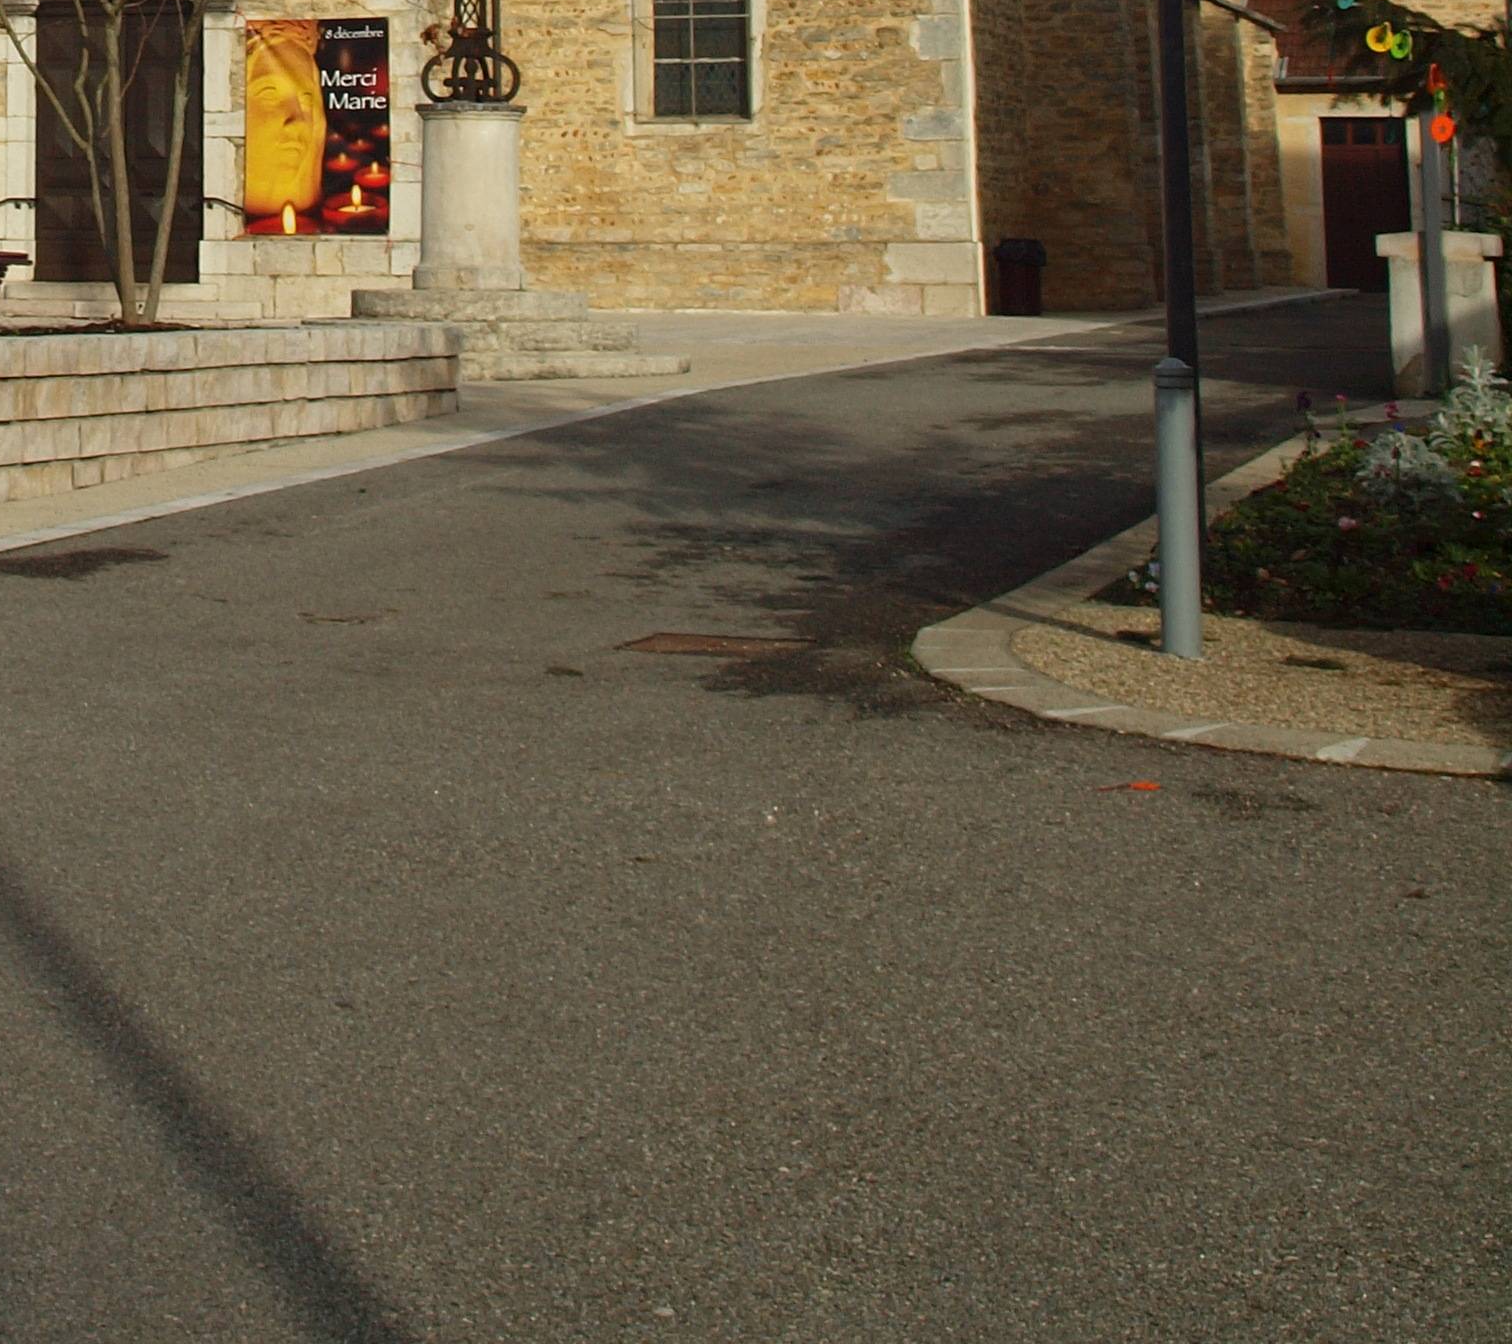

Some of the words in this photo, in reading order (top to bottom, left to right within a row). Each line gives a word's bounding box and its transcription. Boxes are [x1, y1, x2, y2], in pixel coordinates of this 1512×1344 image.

[325, 29, 333, 39] 8
[333, 25, 384, 39] décembre
[320, 67, 378, 87] Merci
[329, 91, 387, 110] Marie
